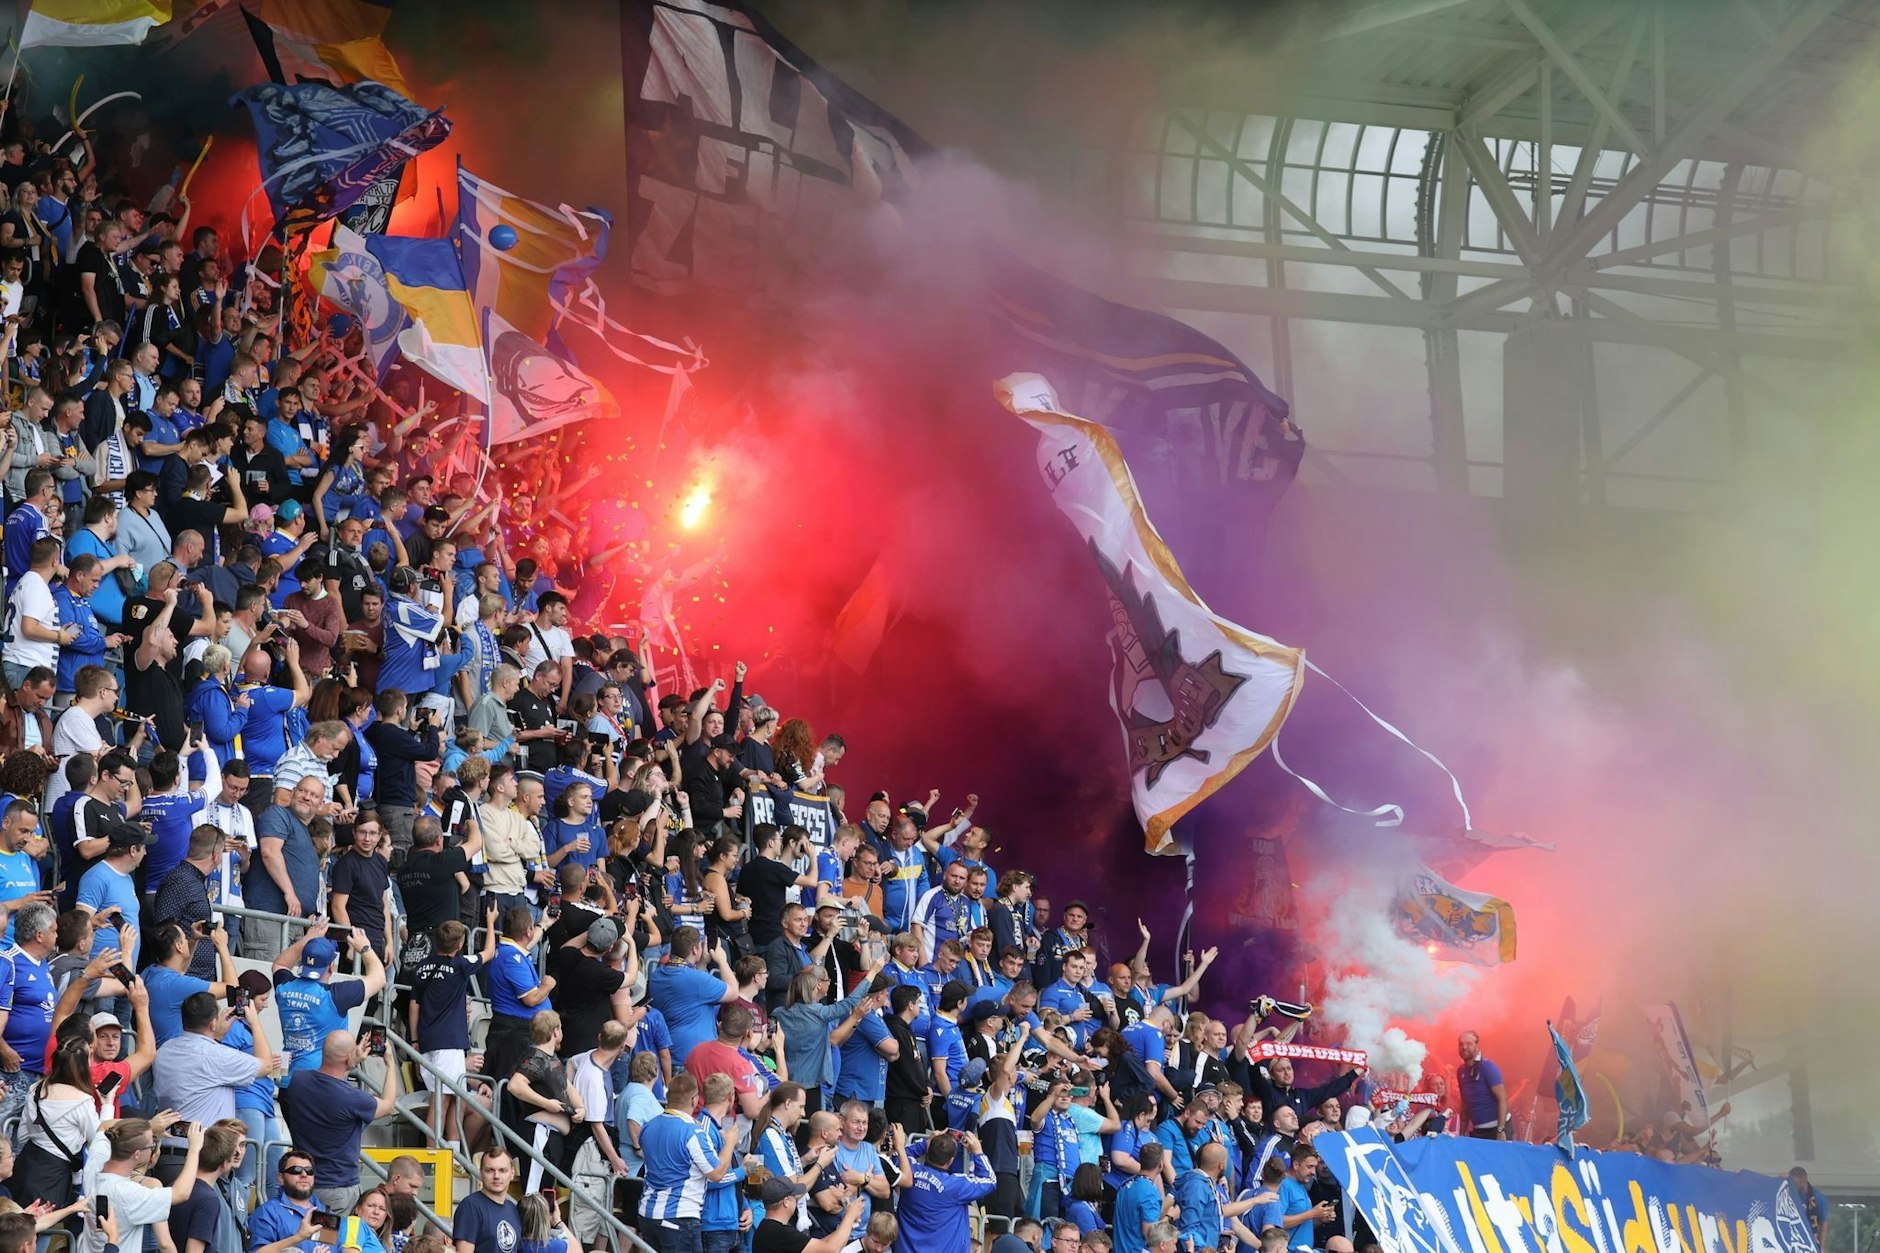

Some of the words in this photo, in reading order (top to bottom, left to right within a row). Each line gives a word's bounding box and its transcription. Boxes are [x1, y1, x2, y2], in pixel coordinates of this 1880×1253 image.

[287, 991, 303, 1000] CARL
[287, 999, 310, 1010] JENA
[1261, 1042, 1366, 1067] SÜDKURVE
[914, 1171, 929, 1180] CARL
[929, 1174, 944, 1193] ZEISS
[915, 1180, 930, 1192] JENA
